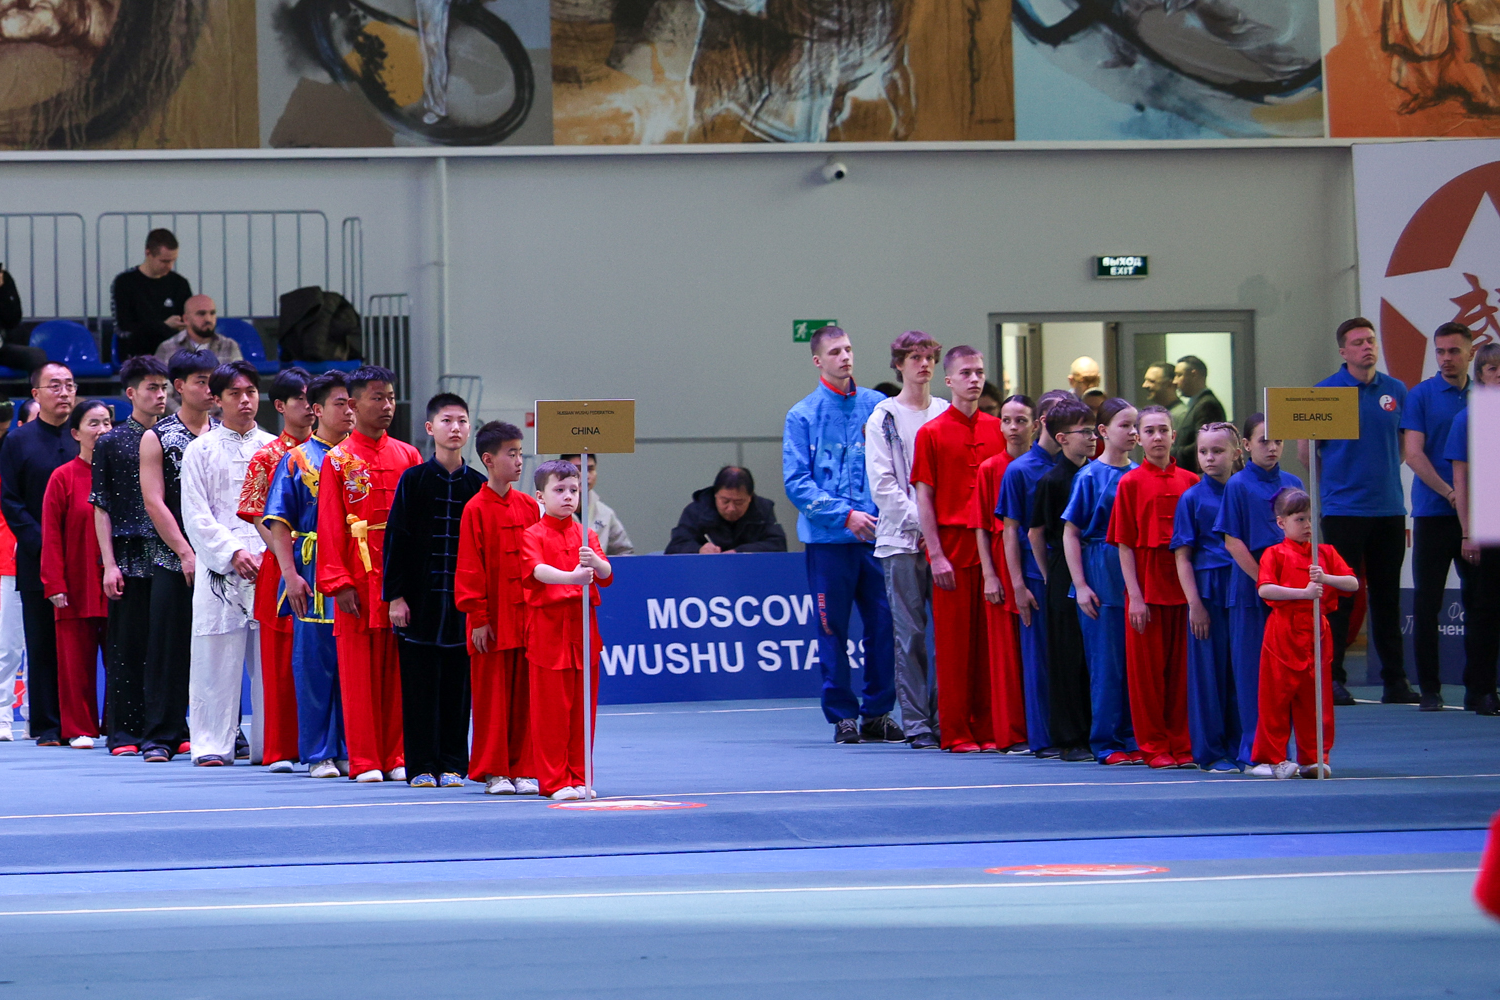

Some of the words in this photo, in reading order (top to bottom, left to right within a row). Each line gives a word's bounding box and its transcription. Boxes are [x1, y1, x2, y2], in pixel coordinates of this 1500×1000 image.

[1102, 256, 1142, 267] ВЫХОД
[1110, 266, 1134, 276] EXIT
[1293, 413, 1333, 421] BELARUS
[571, 426, 600, 435] CHINA
[601, 641, 745, 676] WUSHU
